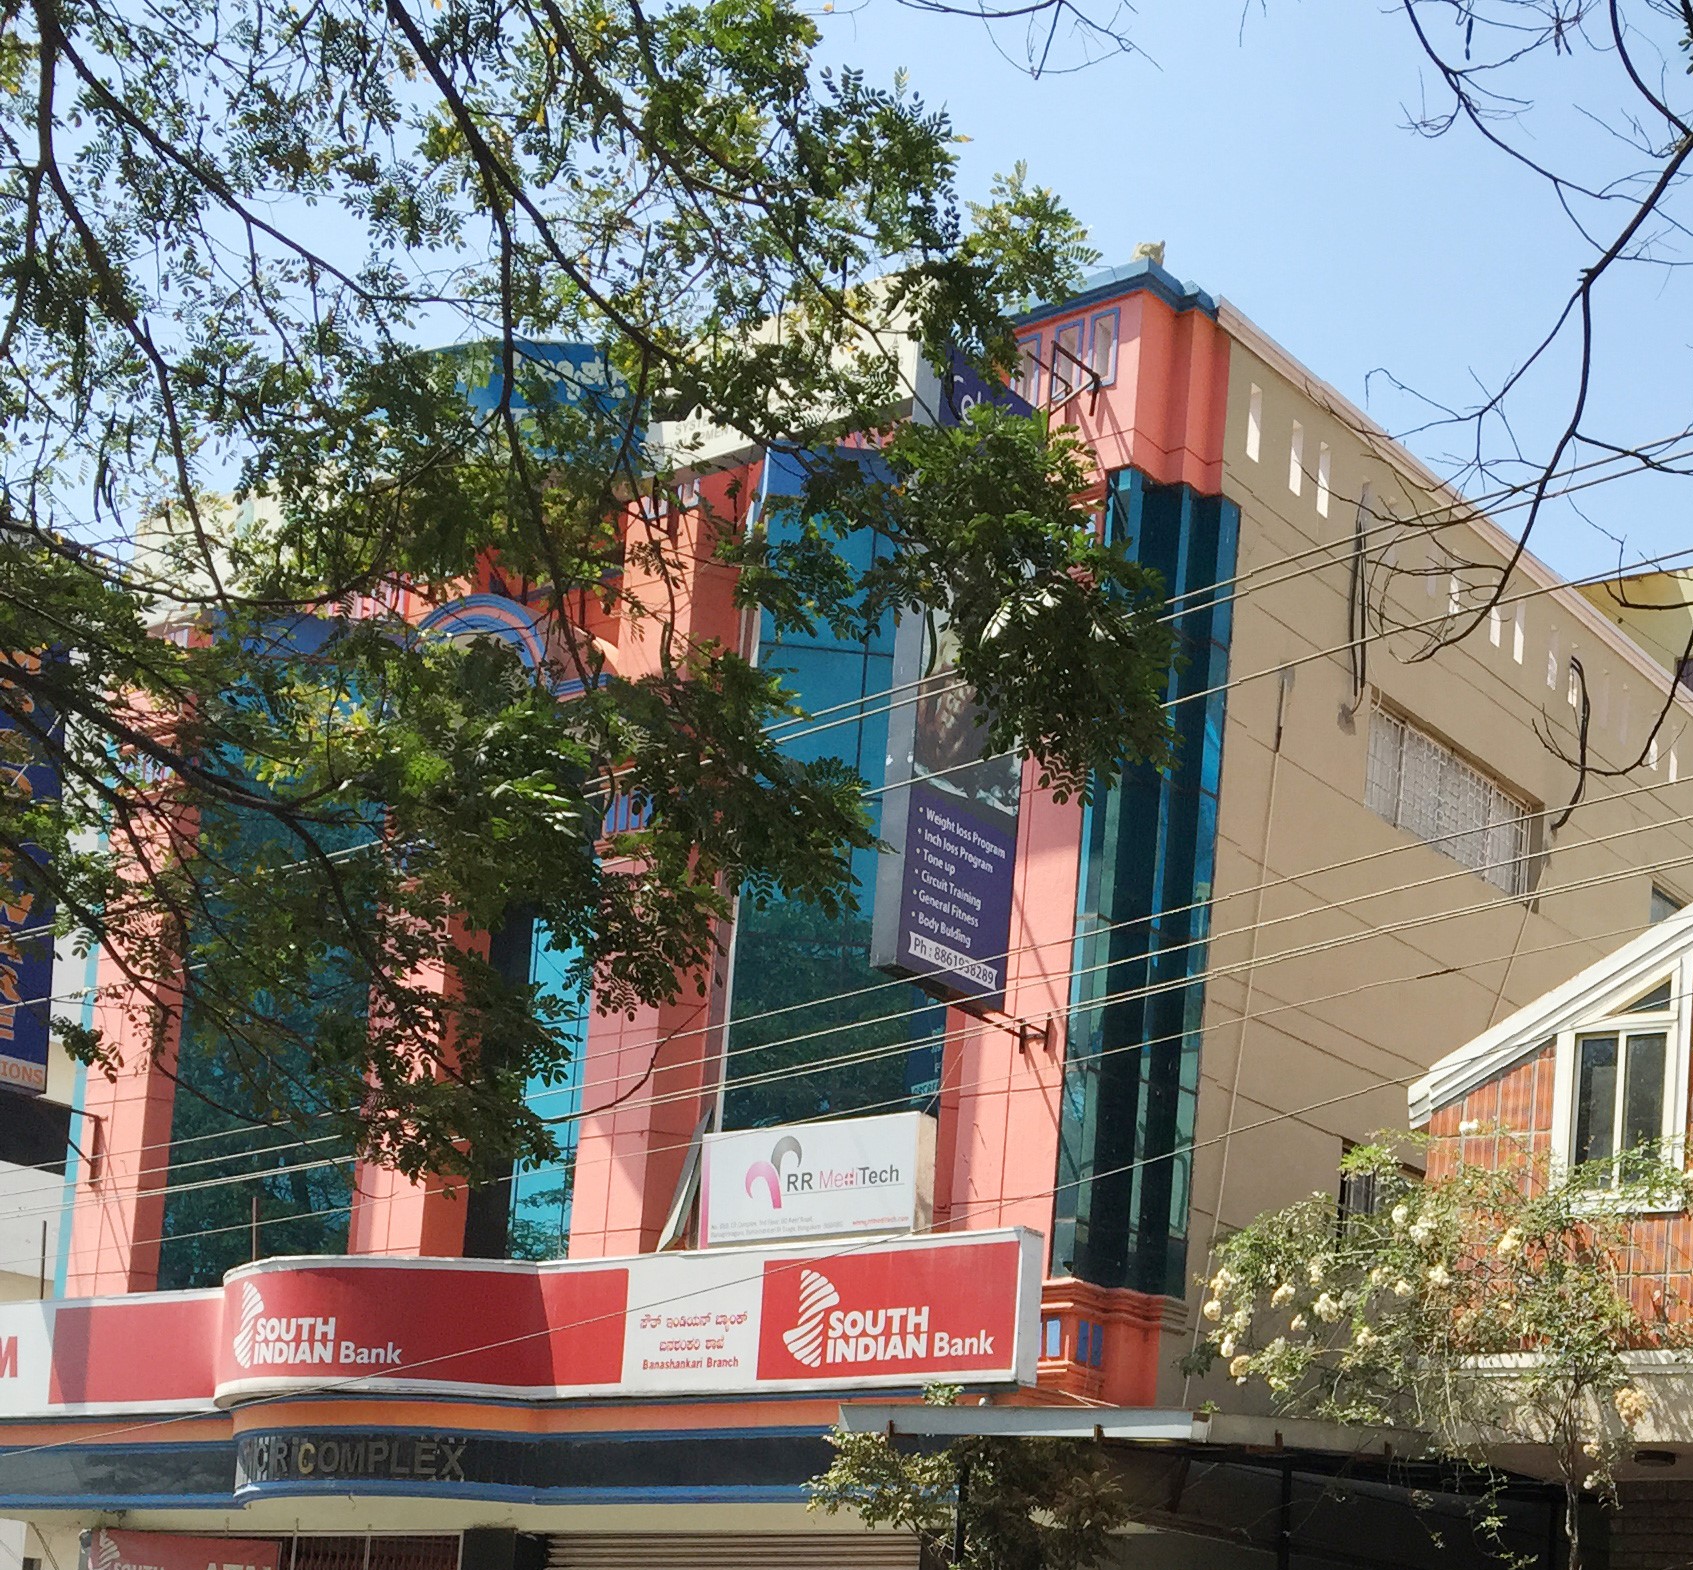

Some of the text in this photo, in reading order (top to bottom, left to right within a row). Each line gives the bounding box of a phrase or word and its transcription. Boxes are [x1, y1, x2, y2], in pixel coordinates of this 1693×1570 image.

[926, 807, 1006, 860] Weight loss Program
[923, 849, 956, 876] Tone up
[924, 829, 993, 874] Inch loss Program
[921, 870, 982, 911] Circuit Training
[918, 911, 940, 935] Body
[919, 890, 979, 928] General Fitness
[786, 1164, 899, 1192] RR MediTech
[255, 1317, 336, 1341] SOUTH
[826, 1306, 930, 1338] SOUTH
[253, 1341, 402, 1365] INDIAN Bank
[642, 1355, 739, 1370] Banashankari Branch
[825, 1329, 995, 1364] INDIAN Bank
[297, 1437, 468, 1480] COMPLEX
